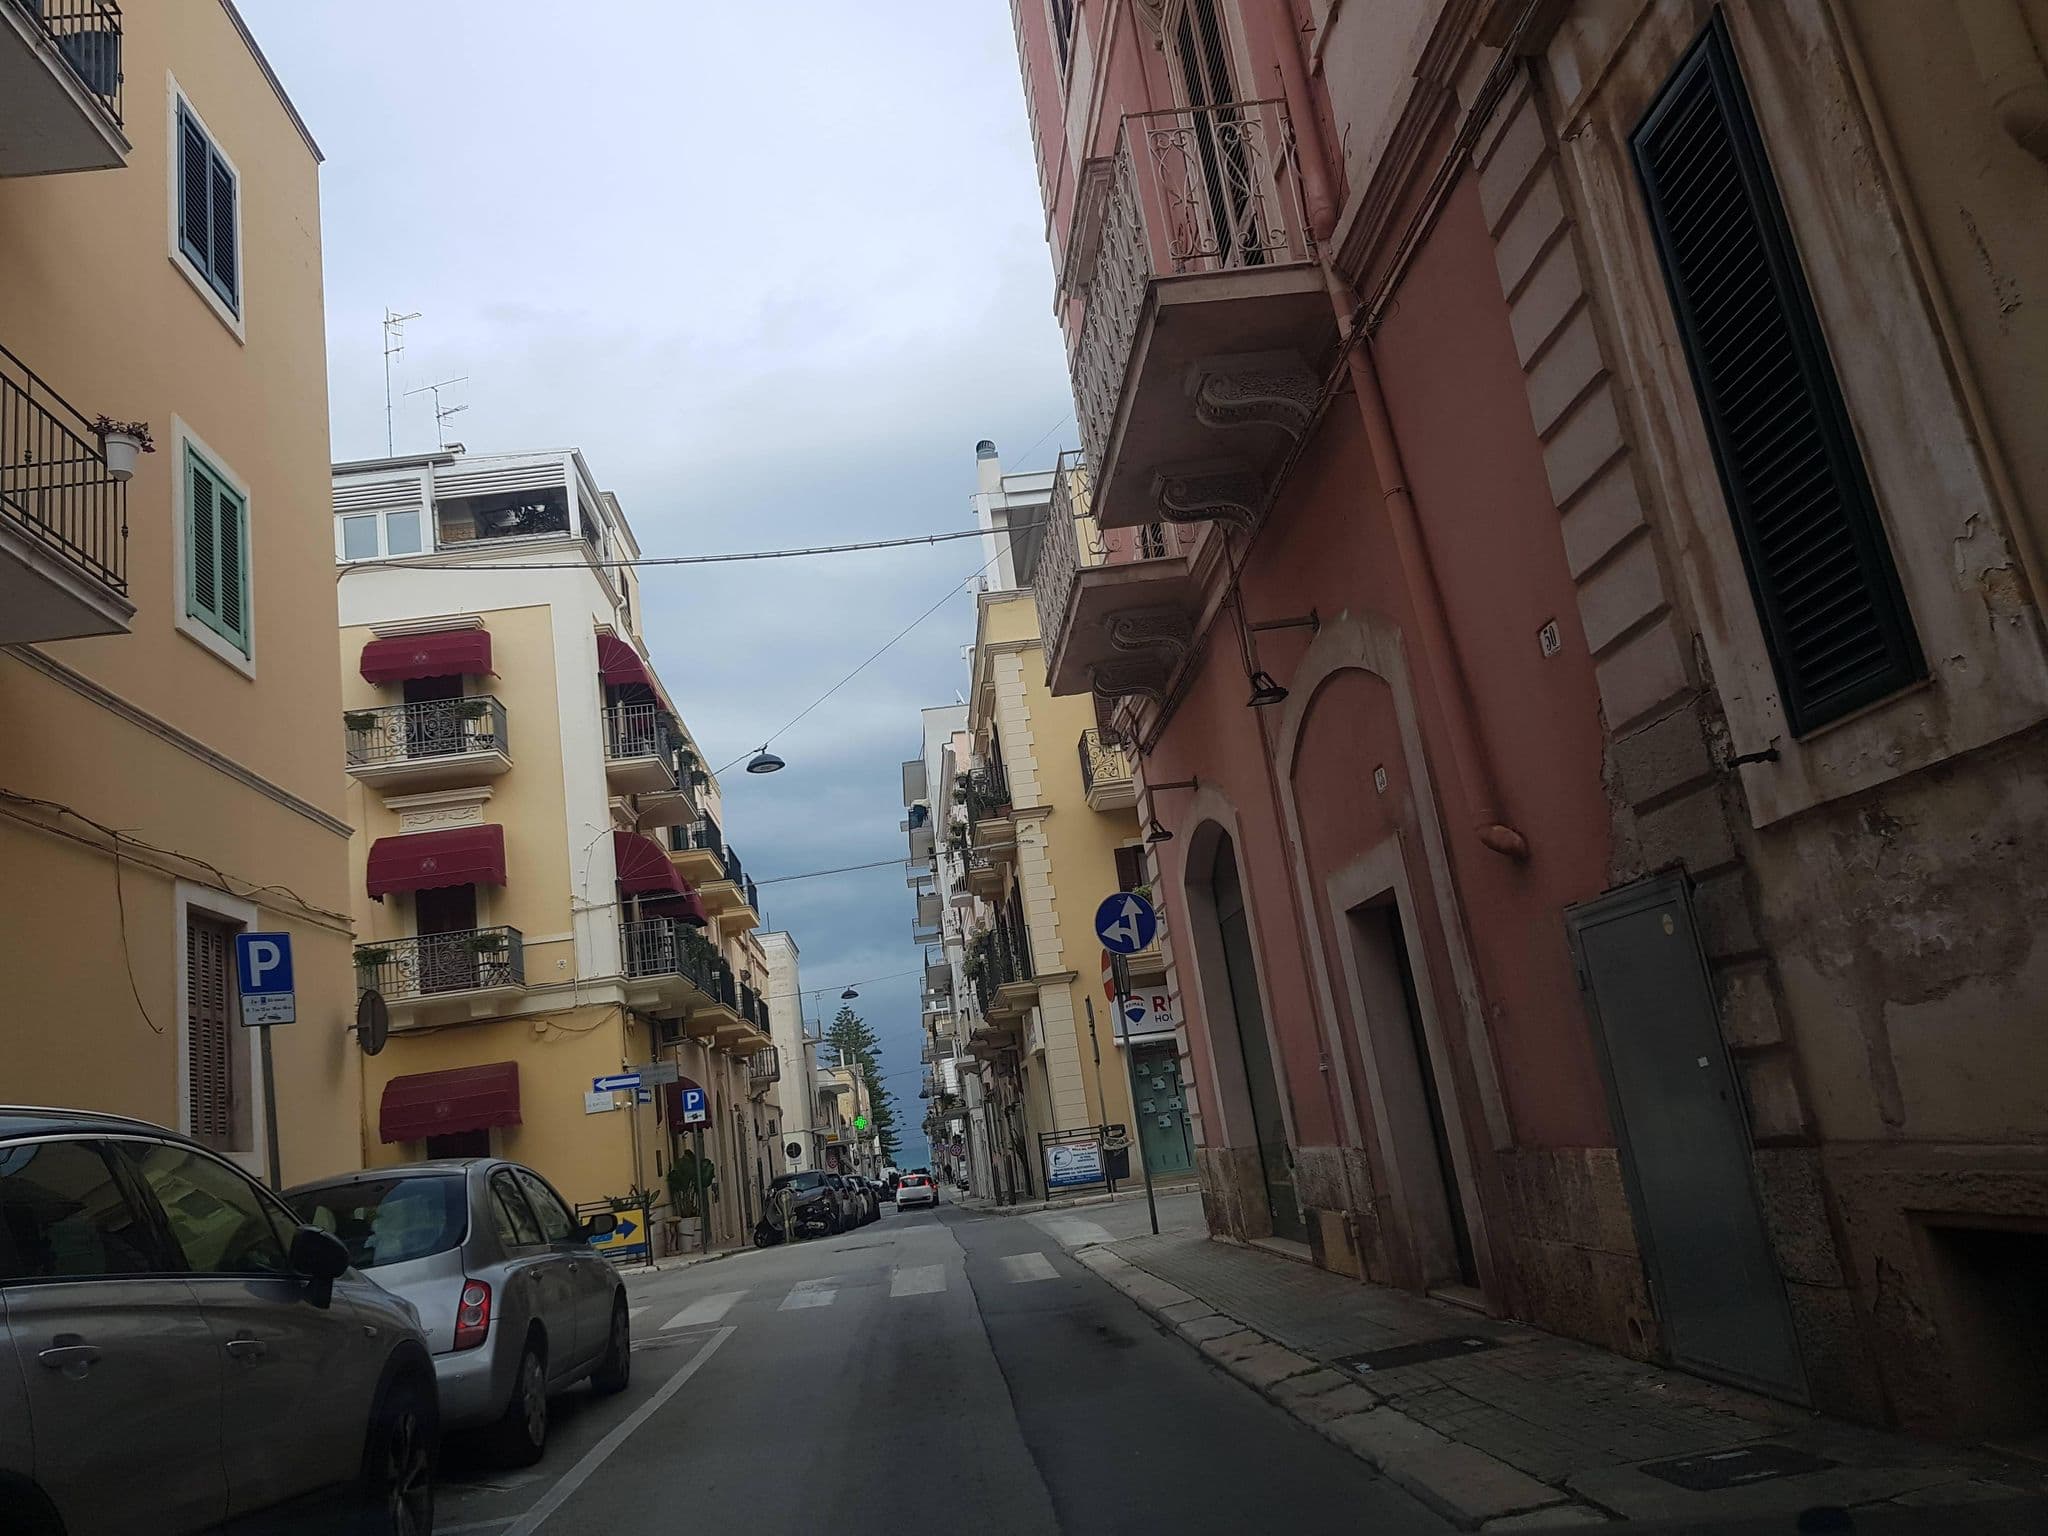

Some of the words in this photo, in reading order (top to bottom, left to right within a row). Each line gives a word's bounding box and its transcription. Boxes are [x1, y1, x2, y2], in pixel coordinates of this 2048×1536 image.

[1543, 625, 1557, 651] 50
[248, 941, 281, 987] P
[686, 1092, 700, 1109] P
